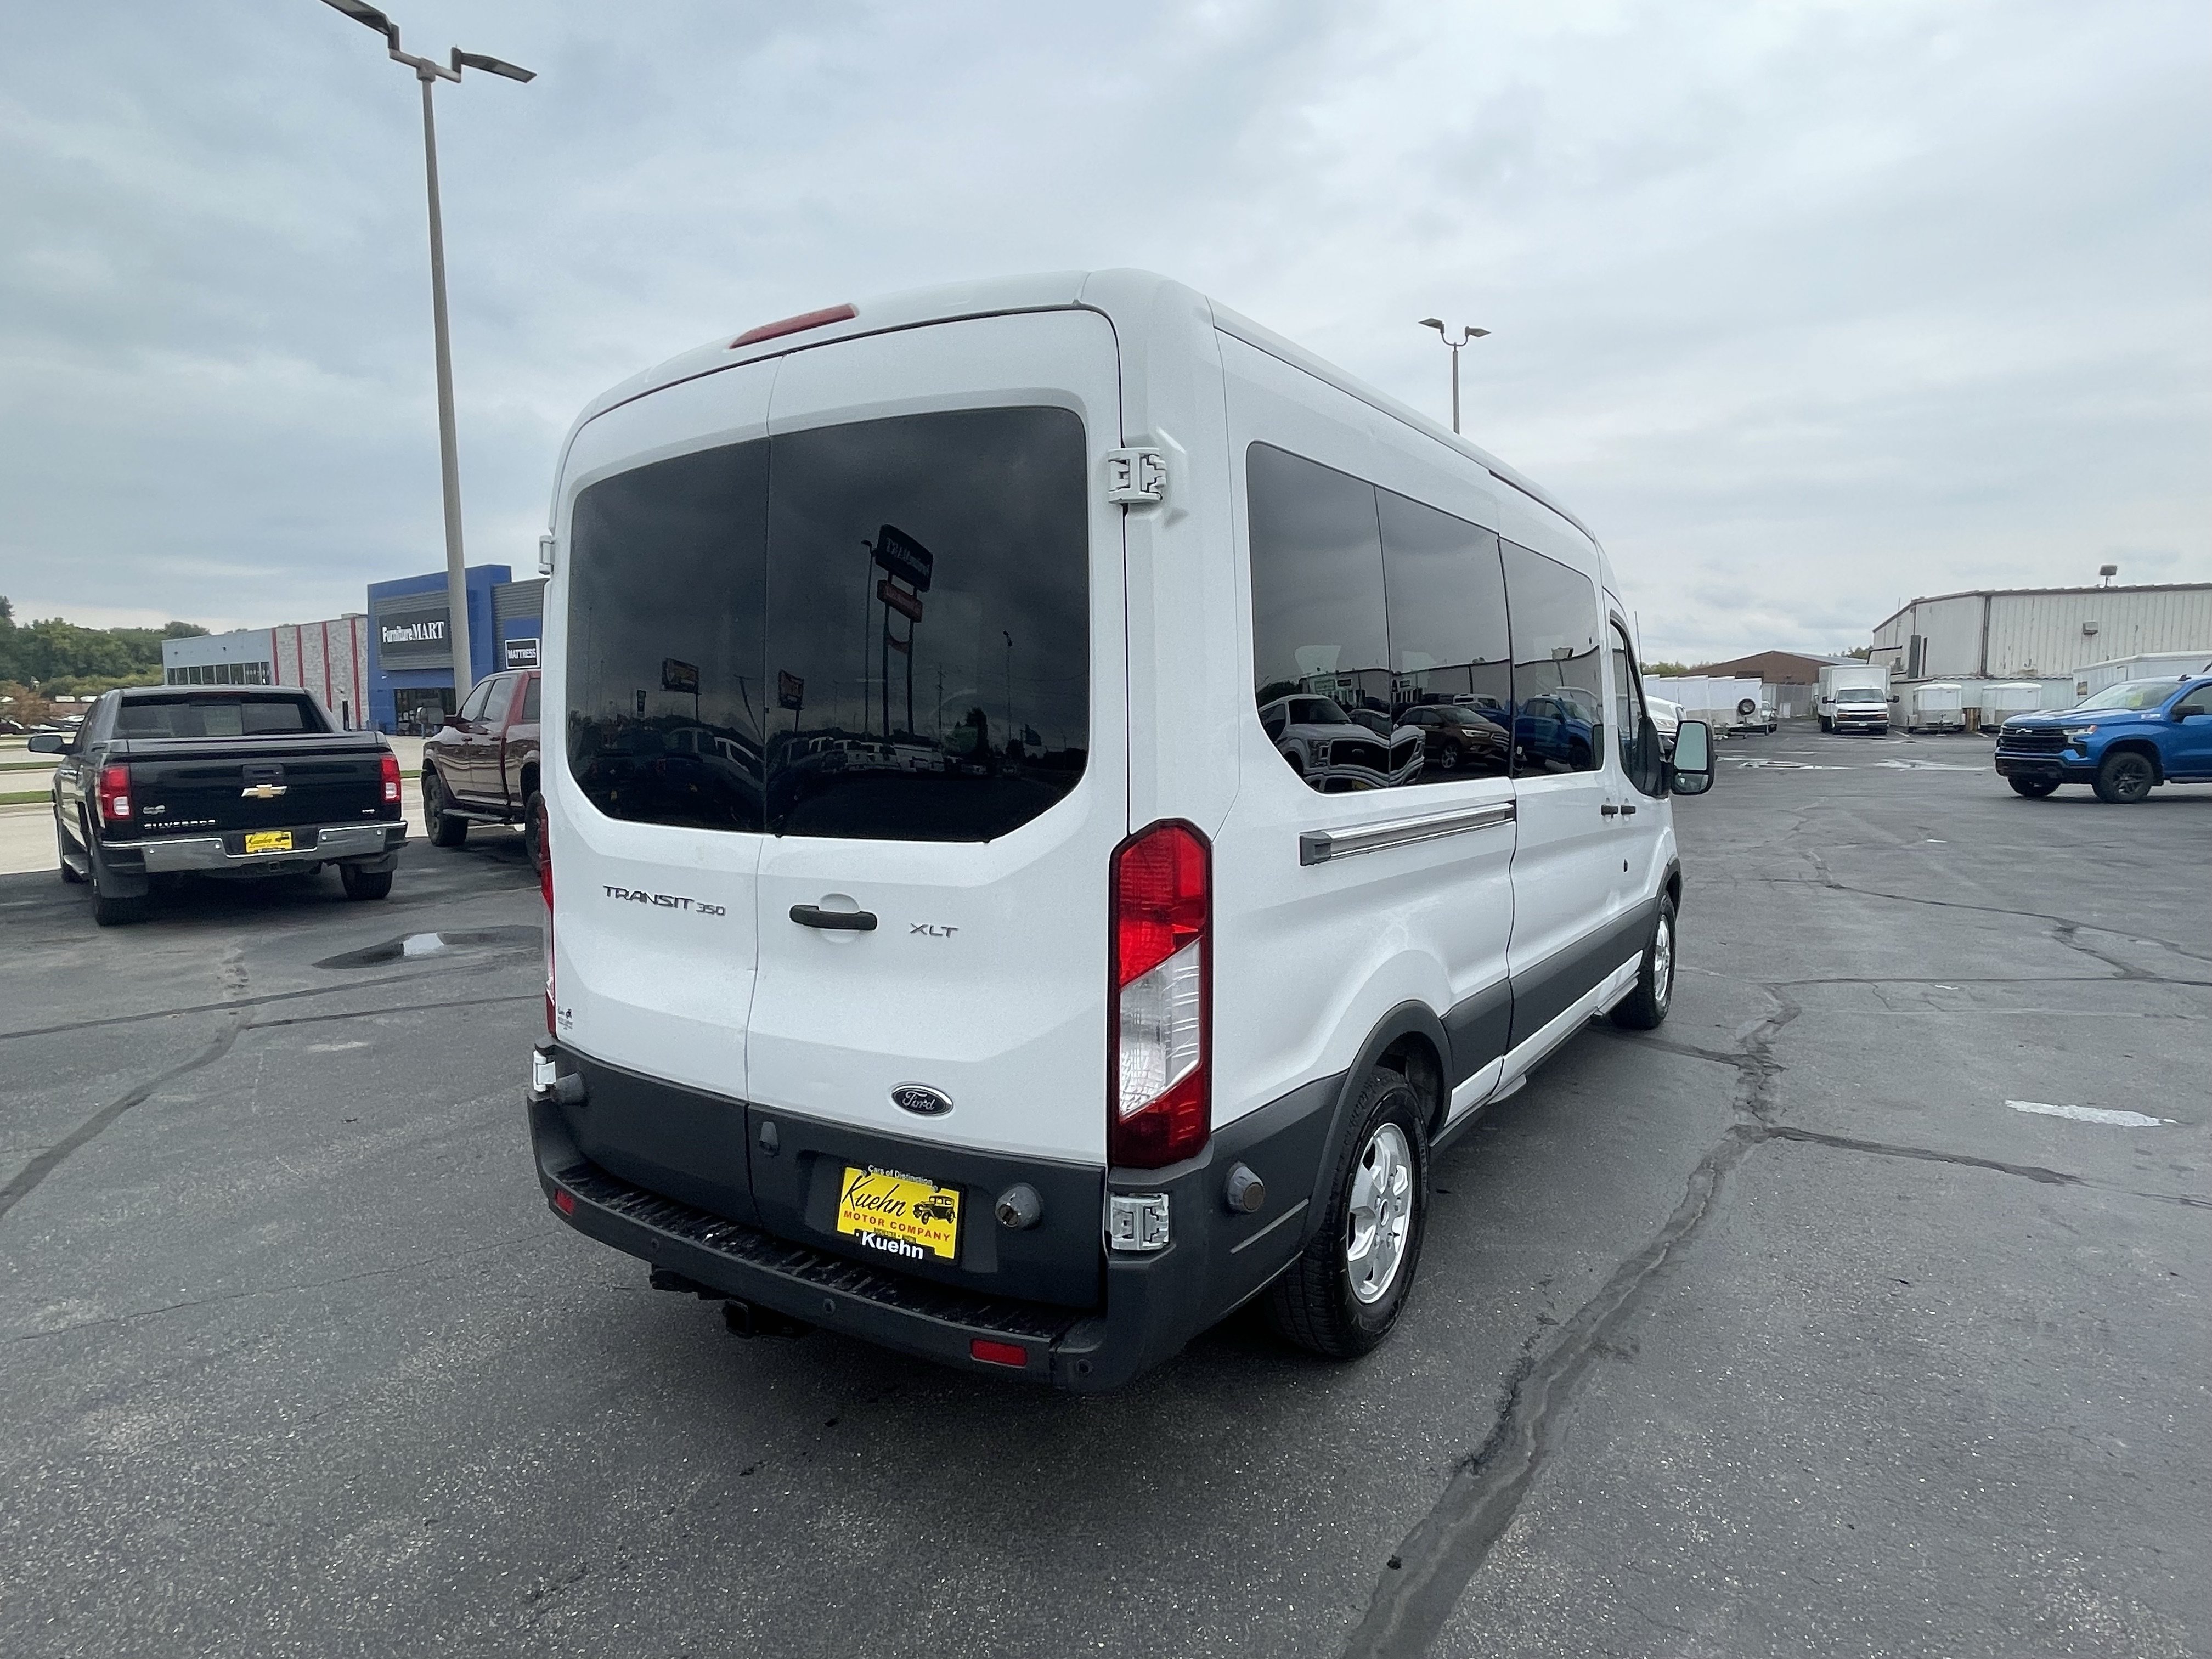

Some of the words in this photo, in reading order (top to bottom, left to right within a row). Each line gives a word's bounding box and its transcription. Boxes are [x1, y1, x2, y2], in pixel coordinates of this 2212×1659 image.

[603, 885, 695, 910] TRANSIT
[696, 902, 725, 916] 350
[910, 923, 958, 938] XLT
[902, 1091, 936, 1110] Ford
[868, 1164, 884, 1176] Cars
[885, 1169, 894, 1177] of
[894, 1170, 933, 1186] Distinction
[842, 1175, 906, 1217] Kuehn
[843, 1210, 884, 1227] MOTOR
[890, 1221, 951, 1242] COMPANY
[861, 1231, 924, 1260] Kuehn
